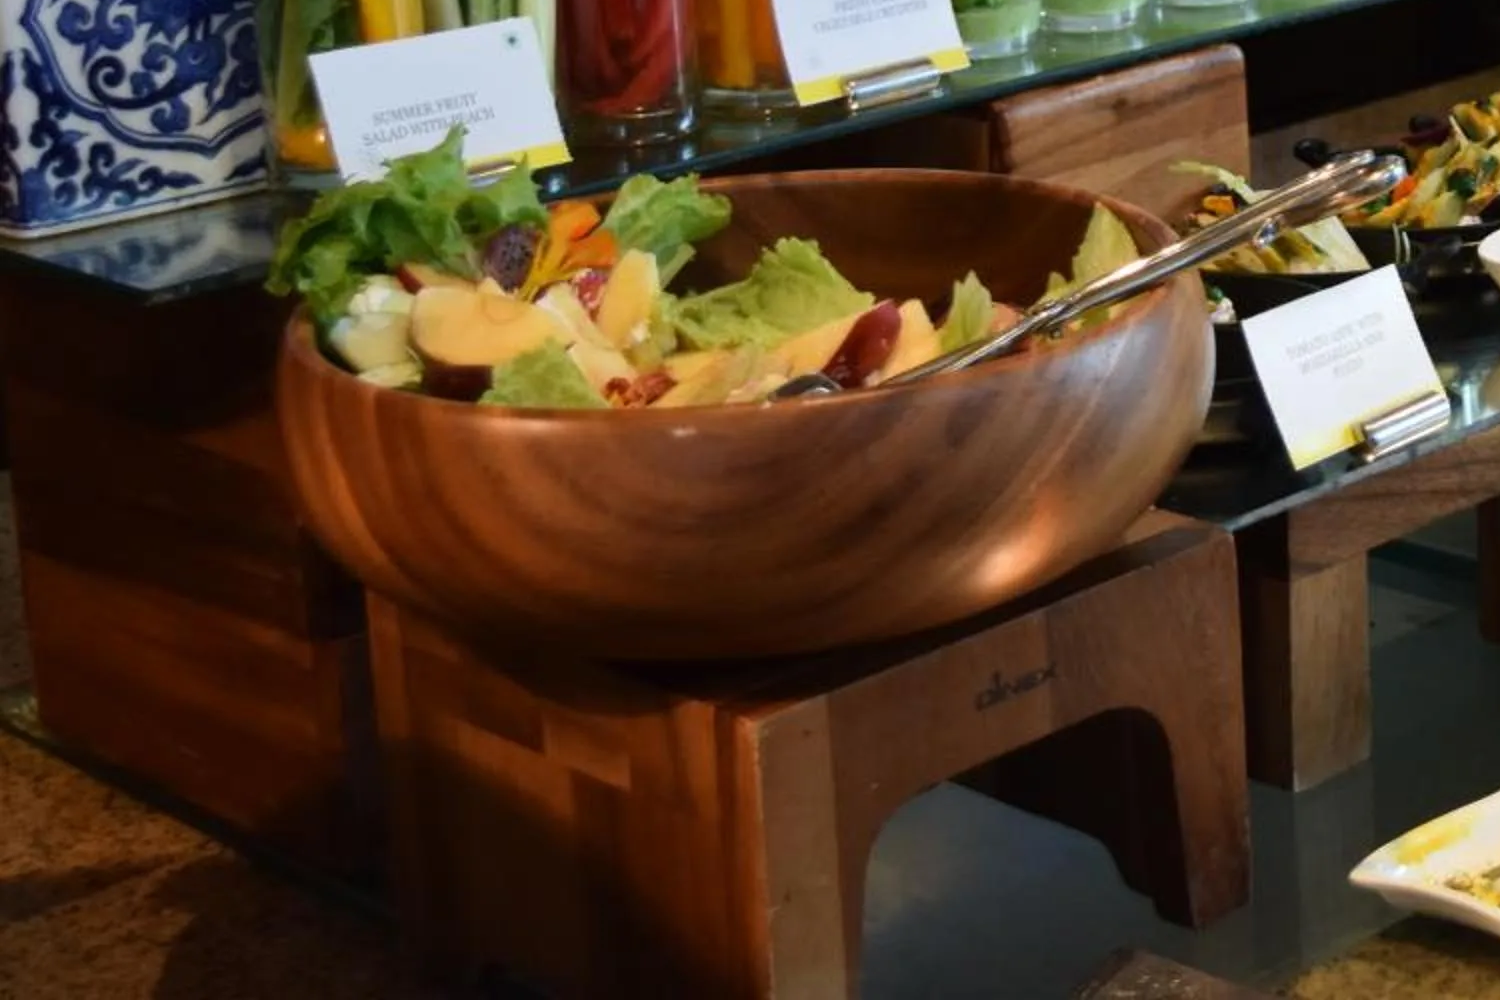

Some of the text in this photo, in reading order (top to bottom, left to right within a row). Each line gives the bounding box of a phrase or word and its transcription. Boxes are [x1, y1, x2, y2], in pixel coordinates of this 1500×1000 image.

[372, 91, 479, 126] SUMMER FRUIT
[362, 122, 409, 147] SALAD
[409, 116, 449, 136] WITH
